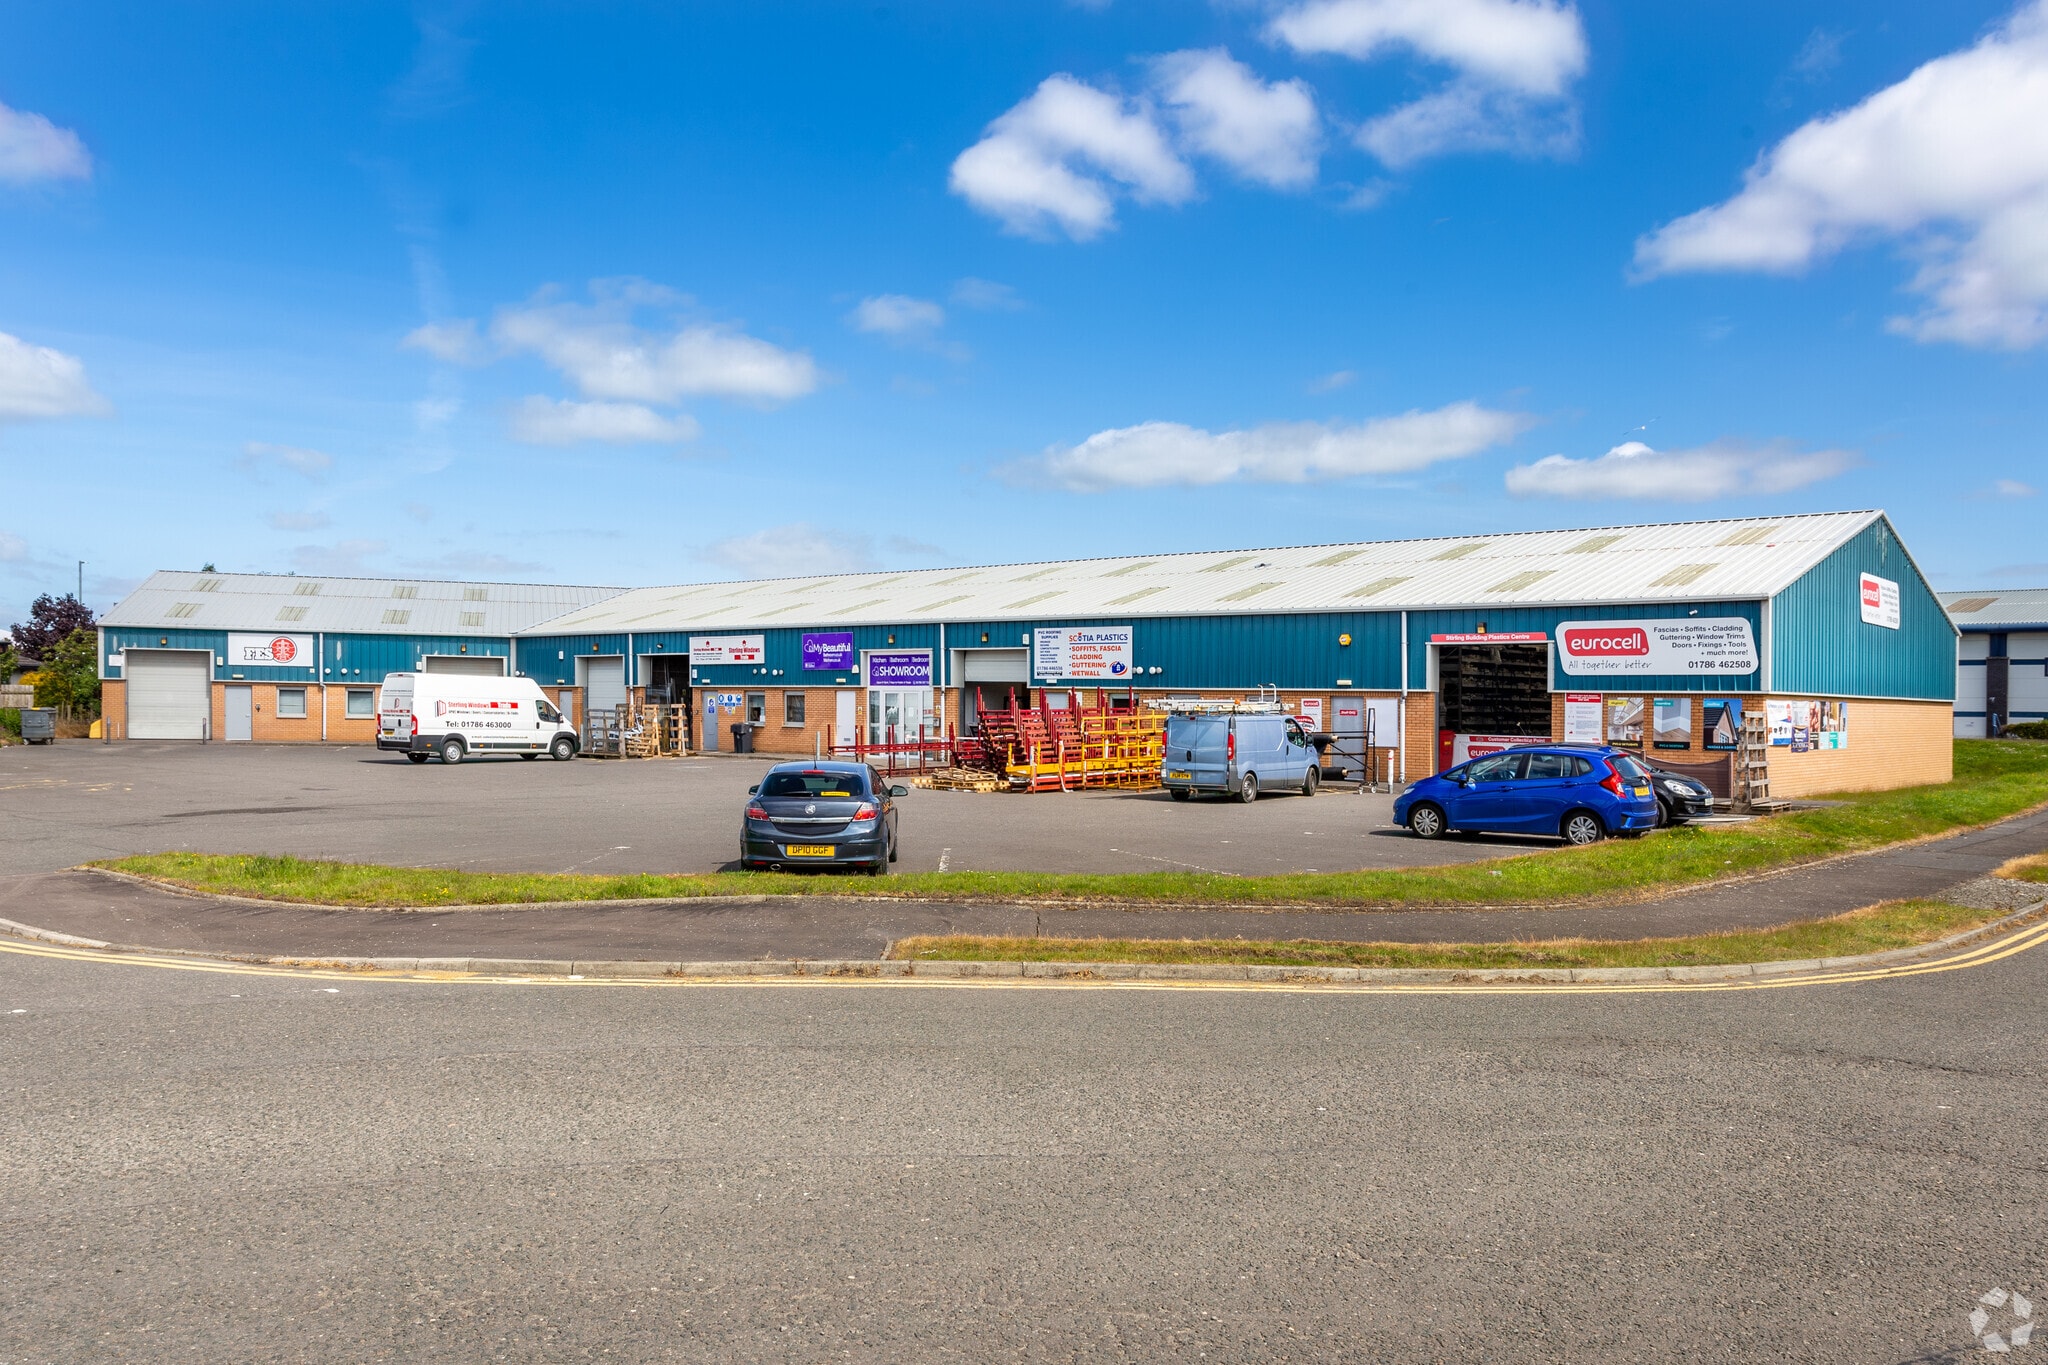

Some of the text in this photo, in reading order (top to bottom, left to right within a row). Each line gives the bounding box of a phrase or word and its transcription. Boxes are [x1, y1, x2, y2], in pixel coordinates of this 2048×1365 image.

[1068, 633, 1128, 641] SCOTIA PLASTICS
[1571, 633, 1641, 650] eurocell
[1697, 641, 1722, 649] Fixings
[244, 647, 274, 661] FES
[1568, 659, 1652, 671] All together better
[1688, 660, 1752, 668] 01786 462508
[879, 666, 929, 676] SHOWROOM
[792, 846, 811, 854] DP10
